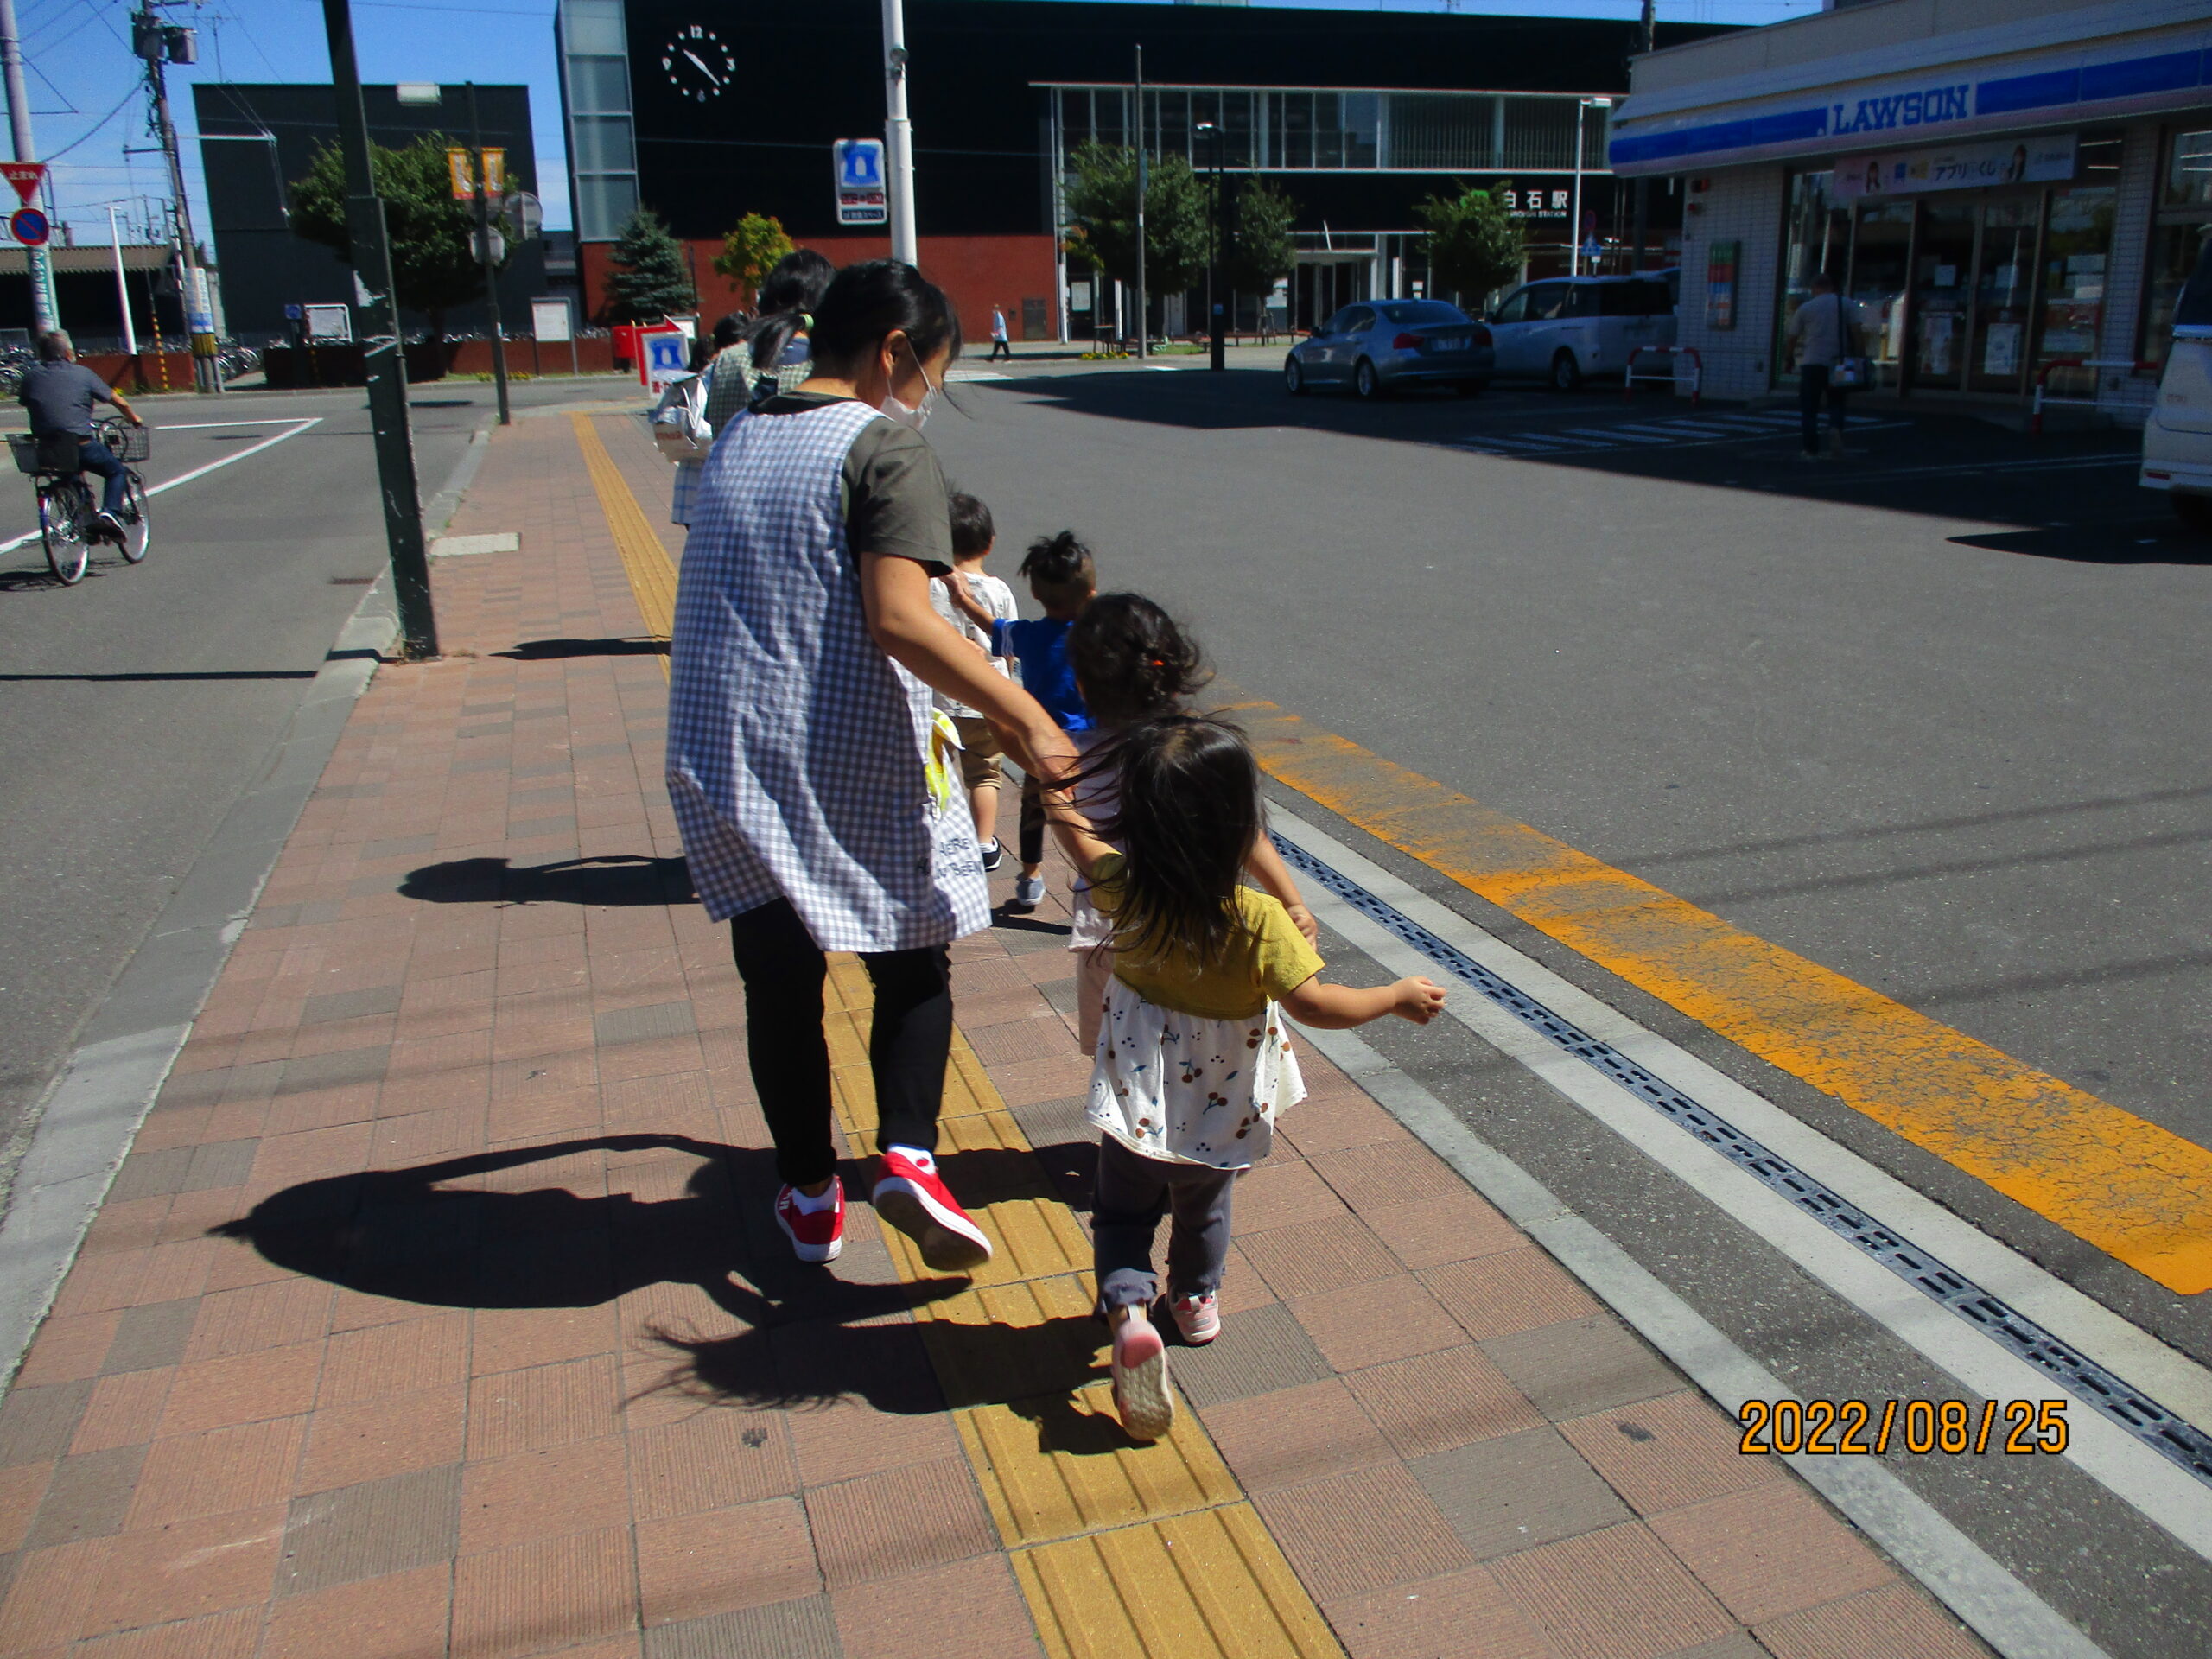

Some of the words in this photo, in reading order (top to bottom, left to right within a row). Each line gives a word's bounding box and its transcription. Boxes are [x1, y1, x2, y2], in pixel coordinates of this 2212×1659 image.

[690, 24, 703, 39] 12
[662, 57, 671, 71] 9
[726, 57, 736, 72] 3
[697, 89, 706, 103] 6
[1833, 85, 1970, 136] LAWSON
[10, 170, 38, 181] 止まれ
[1504, 190, 1568, 208] 白石駅
